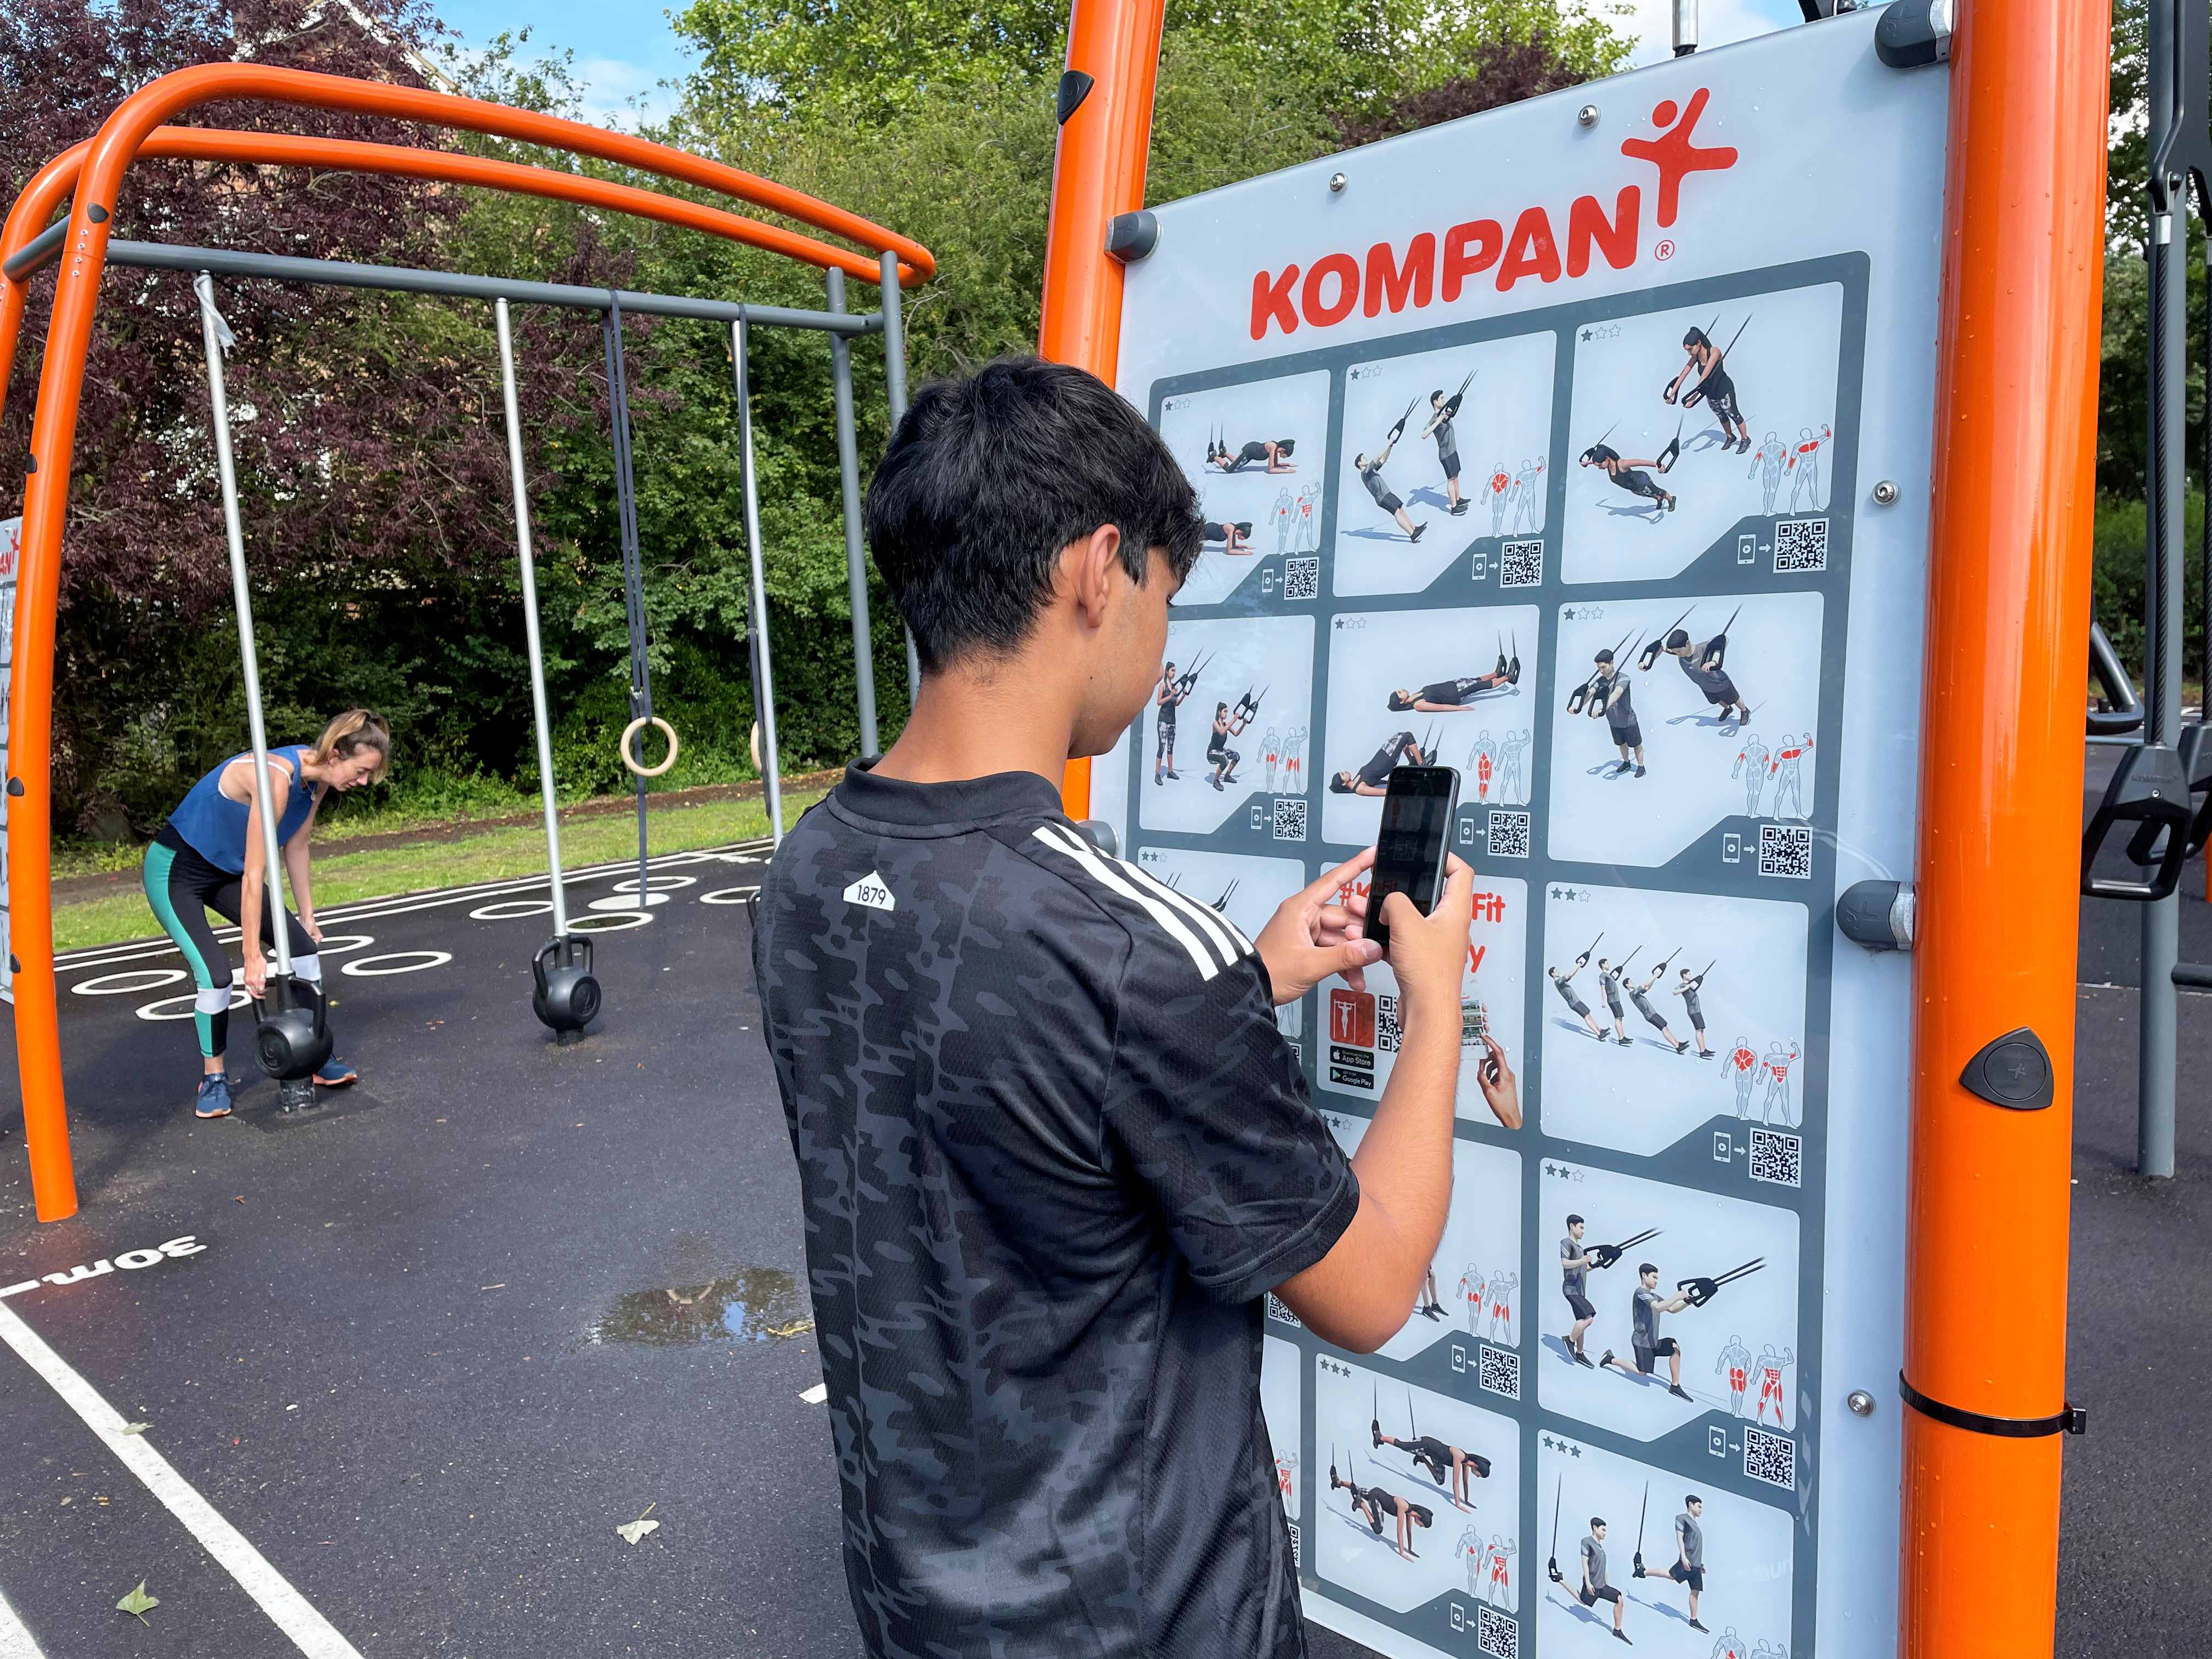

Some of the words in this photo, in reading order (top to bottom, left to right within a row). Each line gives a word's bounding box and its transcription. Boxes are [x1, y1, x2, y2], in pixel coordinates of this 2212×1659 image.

[1250, 185, 1641, 341] KOMPAN
[857, 884, 887, 905] 1879
[1342, 1055, 1354, 1063] App
[1355, 1057, 1371, 1066] Store
[1342, 1075, 1361, 1085] Google
[1361, 1078, 1372, 1087] Play
[41, 1235, 207, 1285] 30m
